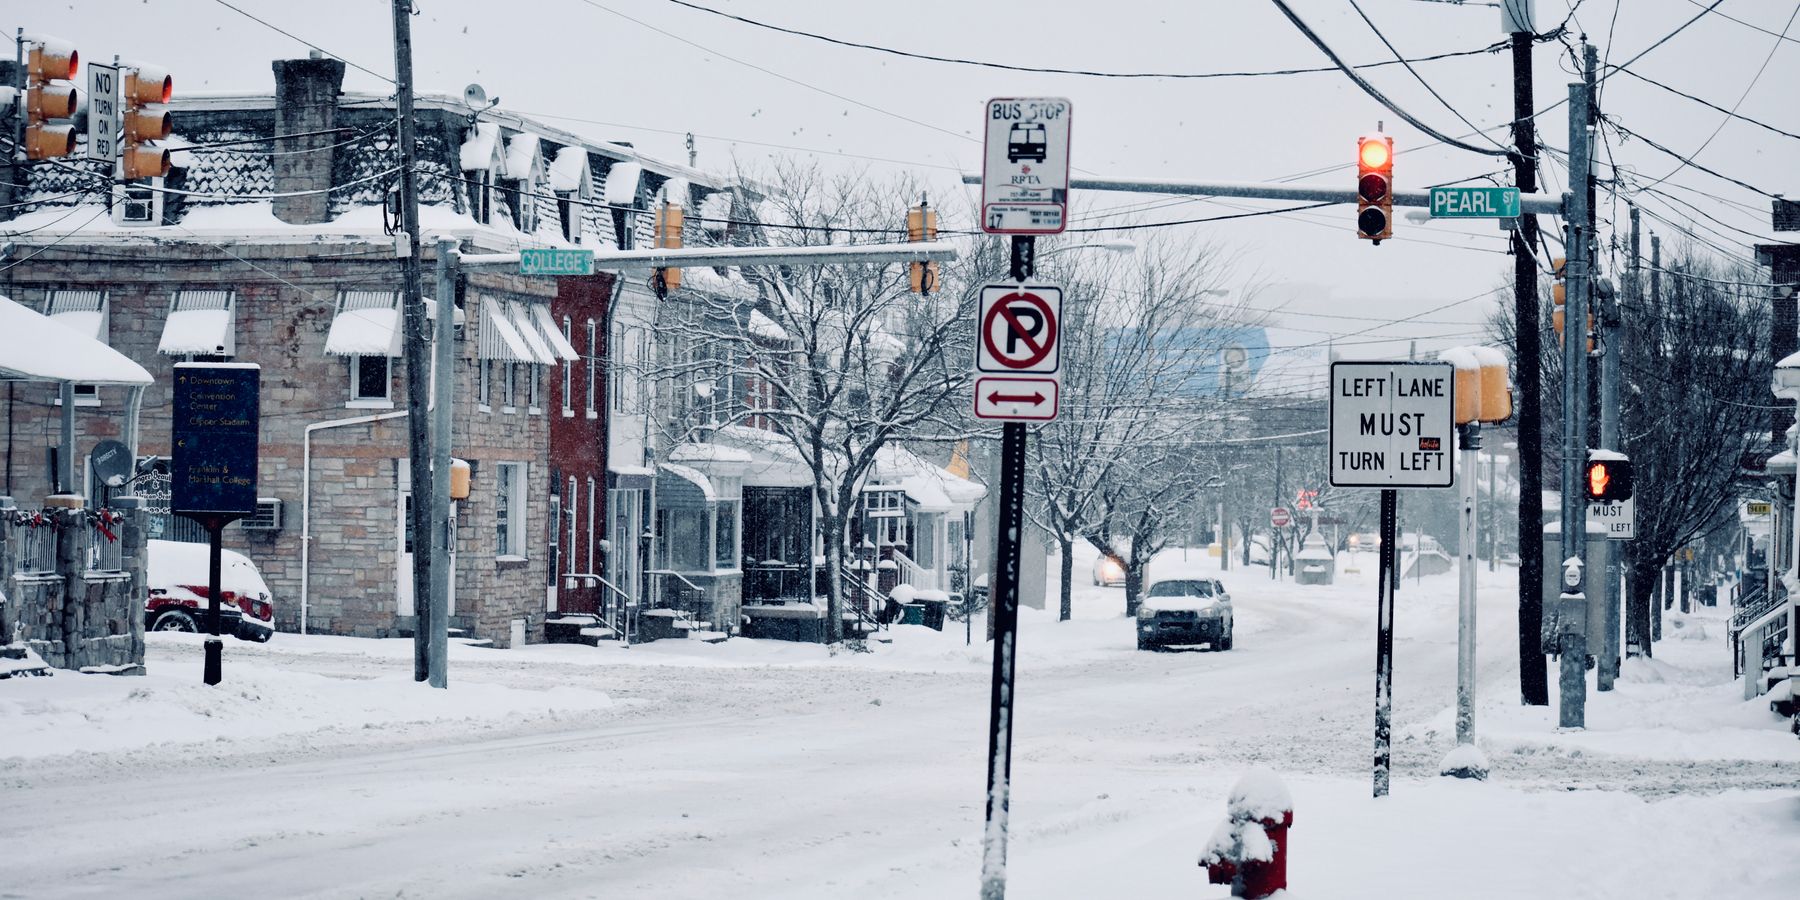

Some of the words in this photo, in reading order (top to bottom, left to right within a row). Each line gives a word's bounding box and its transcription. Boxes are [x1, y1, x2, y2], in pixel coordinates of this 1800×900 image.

[96, 72, 110, 94] NO
[95, 98, 112, 116] TURN
[993, 103, 1021, 120] BUS
[99, 119, 109, 135] ON
[97, 139, 110, 155] RED
[1435, 191, 1497, 213] PEARL
[1503, 191, 1515, 205] ST
[989, 213, 1003, 229] 17
[521, 253, 583, 270] COLLEGE
[191, 376, 235, 385] Downtown
[1342, 378, 1386, 397] LEFT
[1398, 378, 1444, 397] LANE
[1360, 412, 1425, 436] MUST
[223, 465, 229, 474] &
[1339, 452, 1384, 470] TURN
[1400, 452, 1444, 471] LEFT
[223, 475, 251, 487] College
[1593, 506, 1622, 517] MUST
[1611, 523, 1631, 532] LEFT
